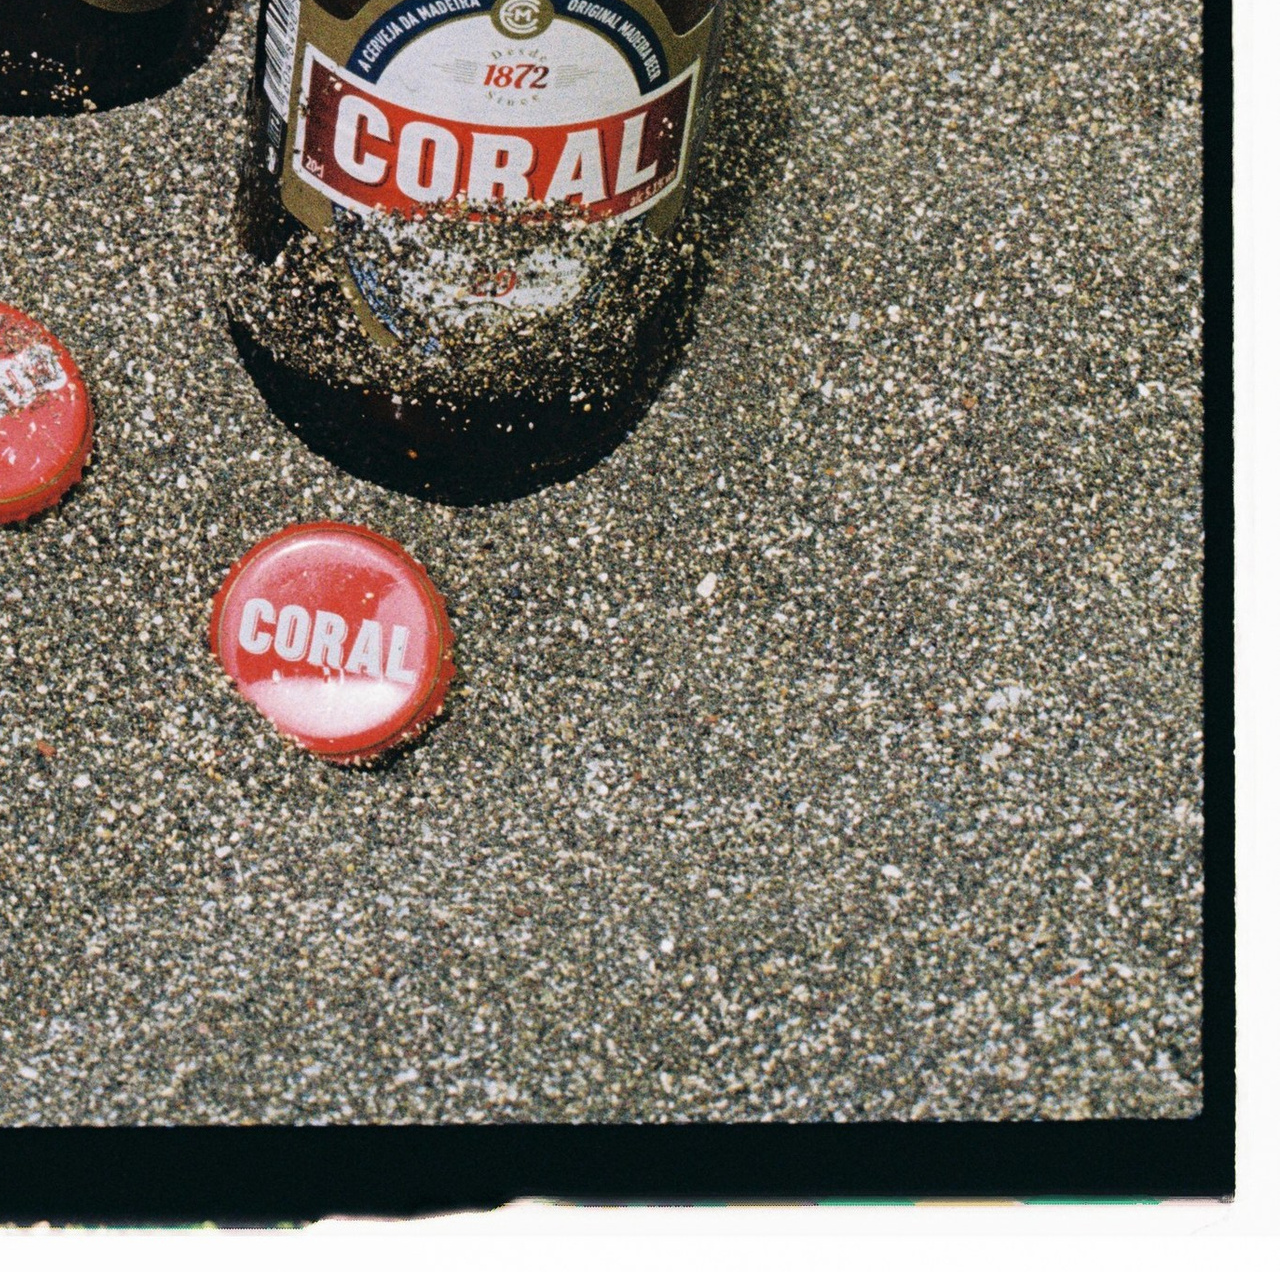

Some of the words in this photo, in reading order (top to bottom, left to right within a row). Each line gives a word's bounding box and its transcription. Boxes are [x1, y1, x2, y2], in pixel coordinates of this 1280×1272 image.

[398, 11, 420, 30] DA
[362, 21, 404, 63] CERVEJA
[617, 20, 653, 60] MADEIRA
[643, 54, 662, 83] BEER
[357, 59, 372, 73] A
[483, 64, 549, 90] 1872
[333, 94, 658, 206] CORAL
[238, 596, 417, 685] CORAL
